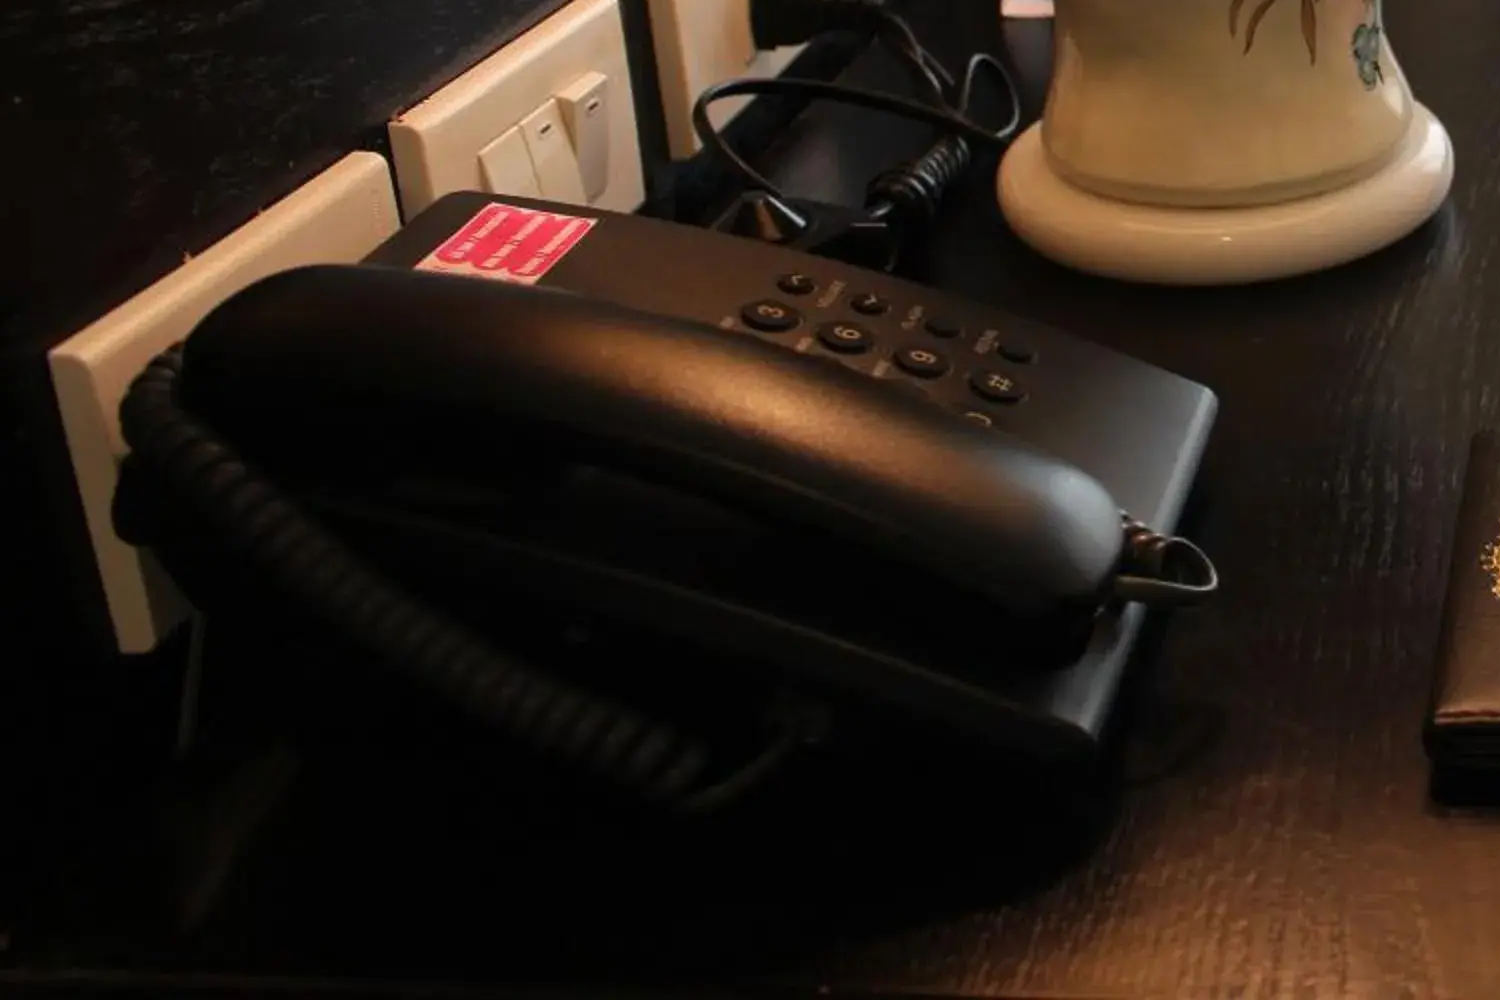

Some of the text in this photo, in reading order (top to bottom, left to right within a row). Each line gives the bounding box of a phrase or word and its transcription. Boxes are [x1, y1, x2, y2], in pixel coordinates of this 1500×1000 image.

[757, 304, 784, 319] 3
[833, 325, 862, 341] 6
[910, 350, 937, 365] 9
